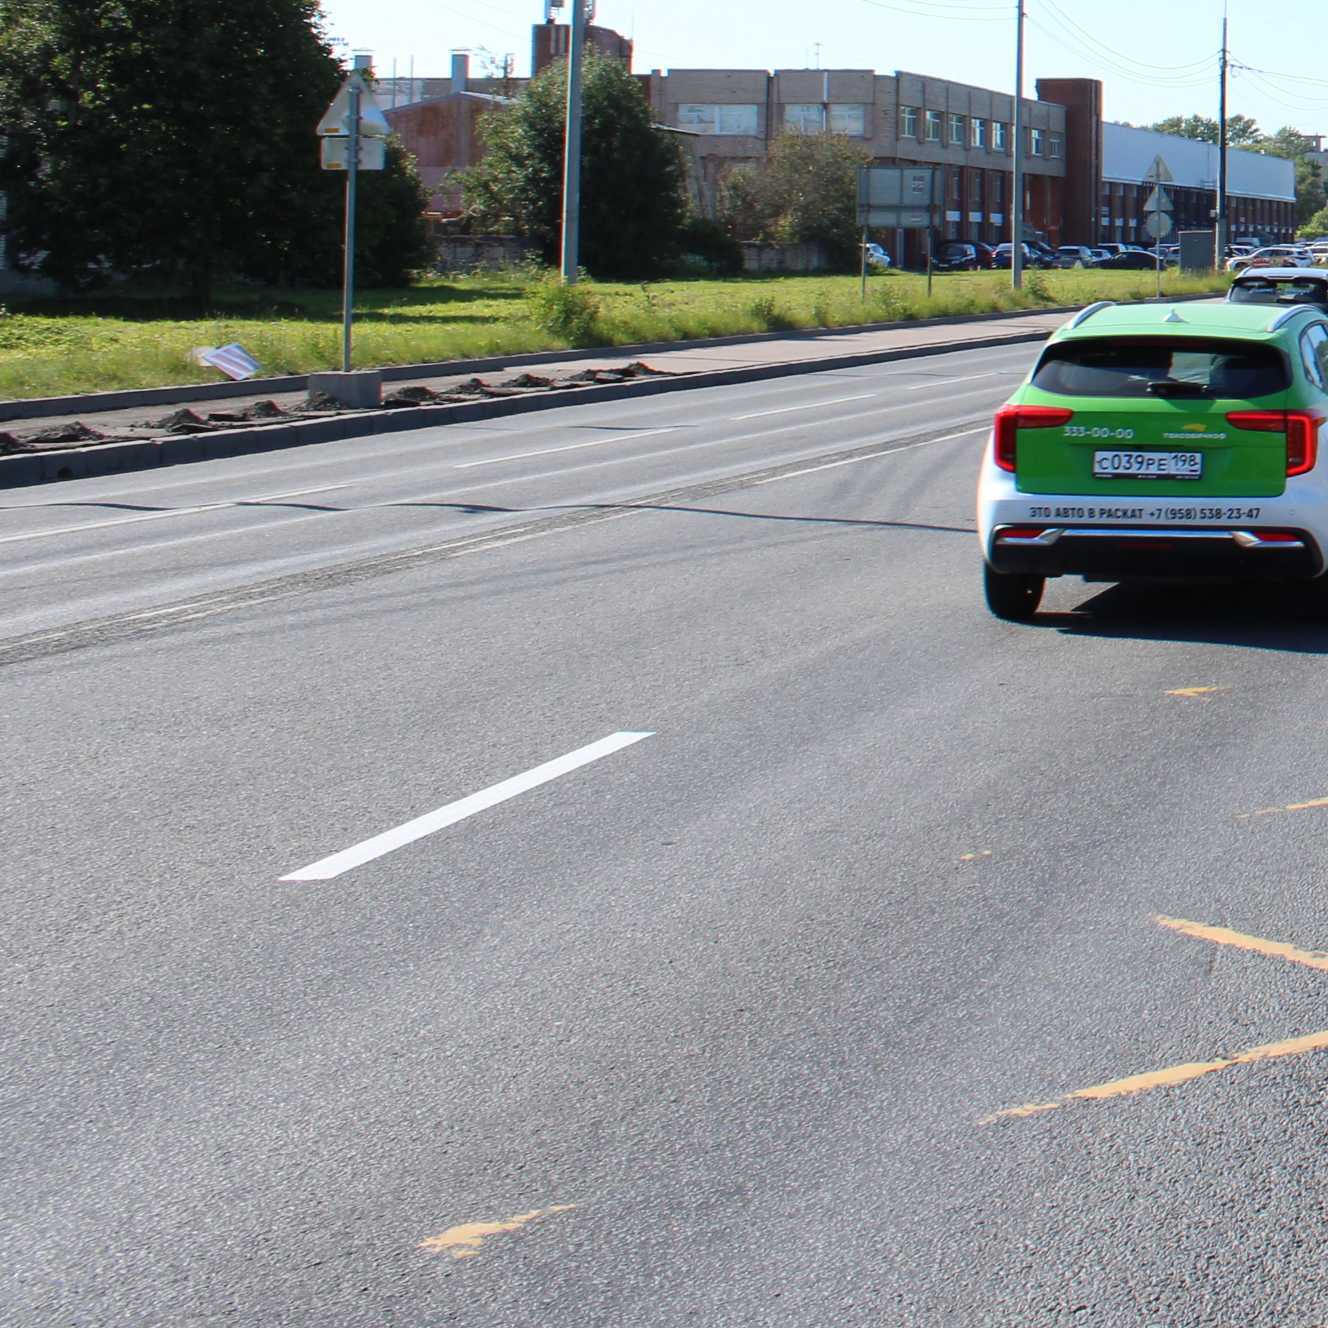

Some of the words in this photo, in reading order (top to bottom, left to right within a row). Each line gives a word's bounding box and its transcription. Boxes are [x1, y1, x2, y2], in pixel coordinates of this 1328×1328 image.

[1029, 506, 1052, 518] ЭТО
[1055, 507, 1085, 519] АВТО
[1087, 507, 1096, 519] В
[1099, 507, 1144, 520] РАСКАТ
[1149, 508, 1163, 520] +7
[1165, 508, 1197, 521] (958)
[1200, 508, 1261, 520] 538-23-47
